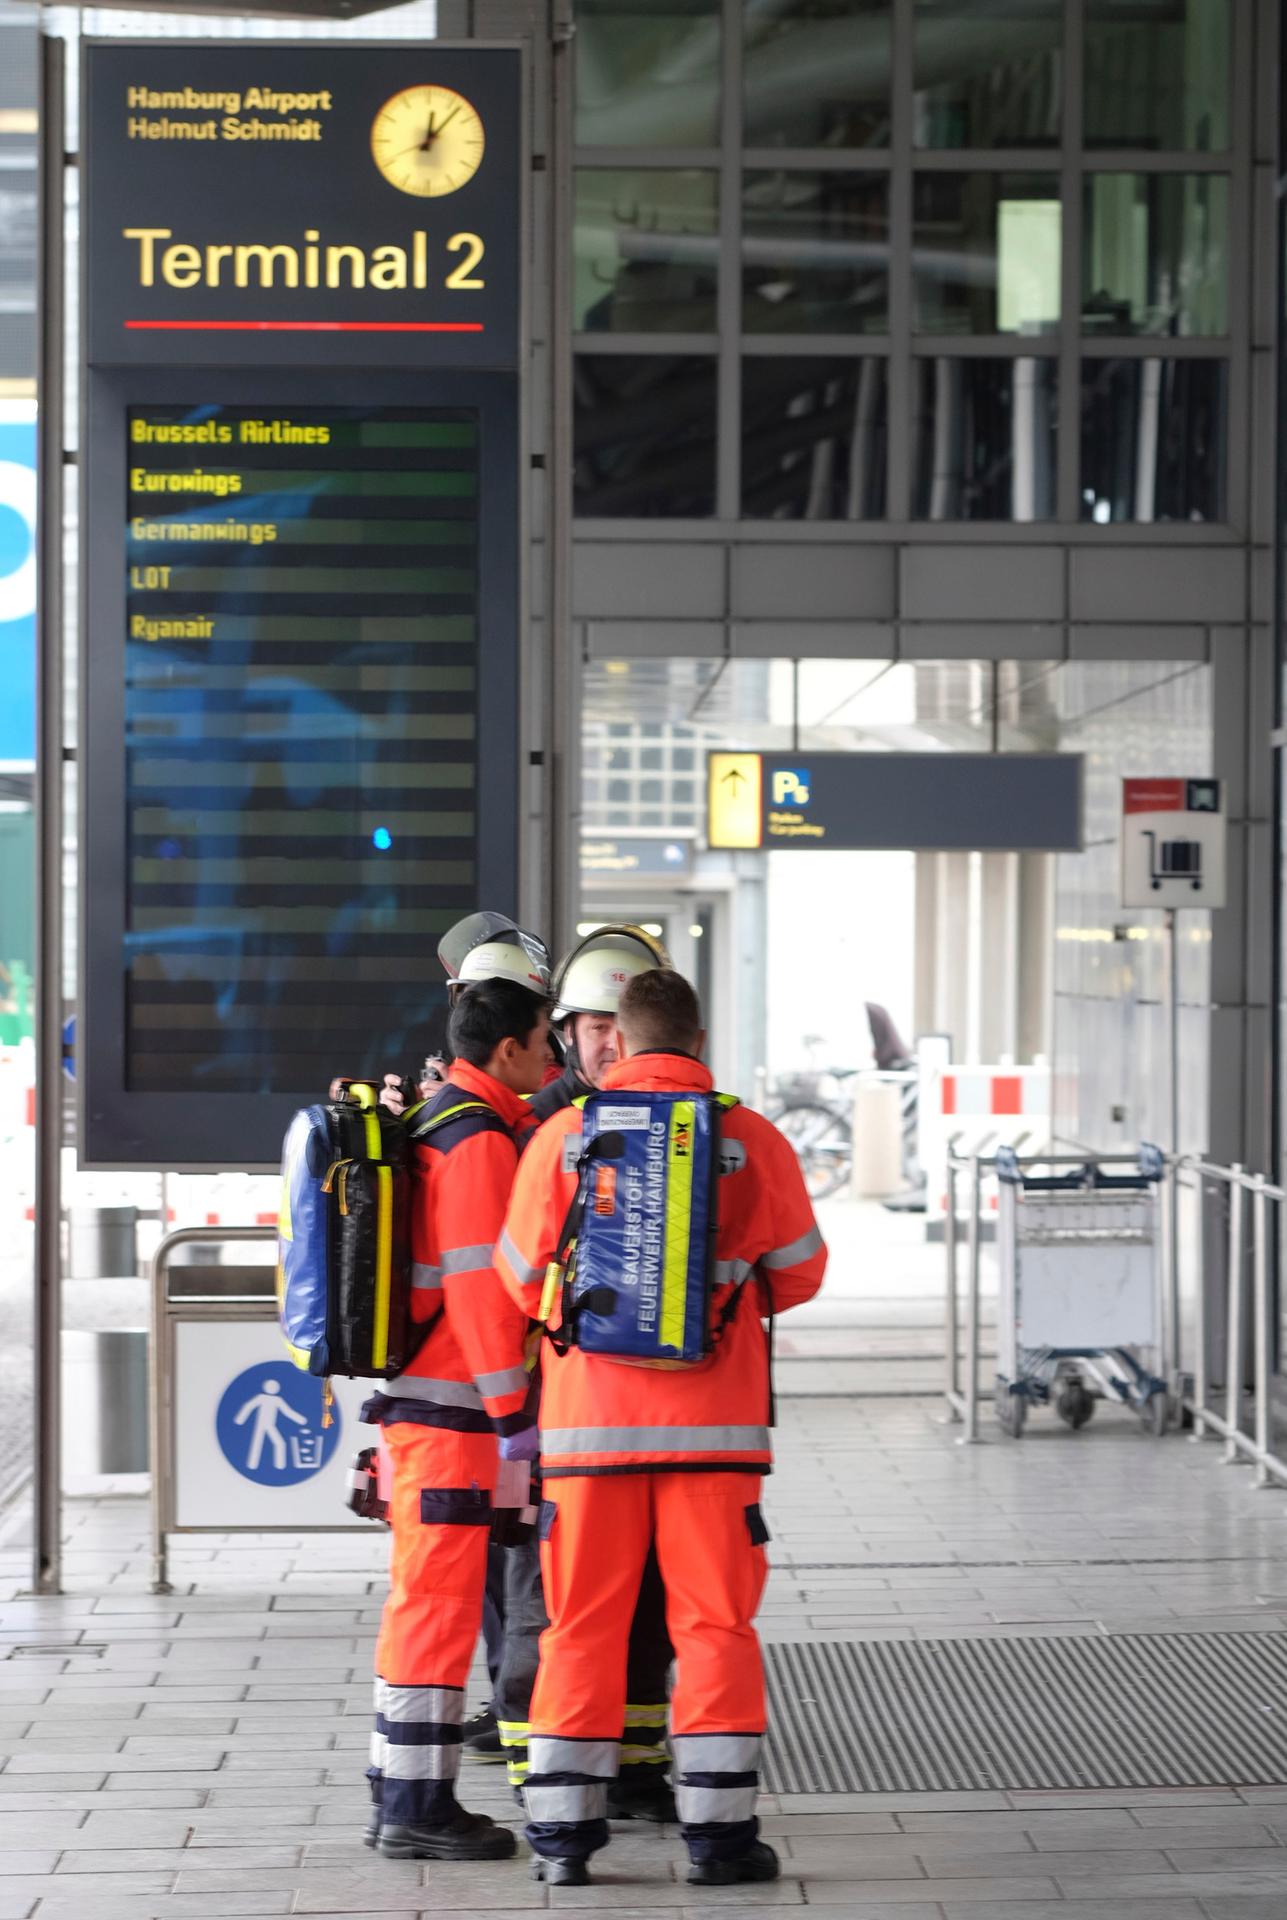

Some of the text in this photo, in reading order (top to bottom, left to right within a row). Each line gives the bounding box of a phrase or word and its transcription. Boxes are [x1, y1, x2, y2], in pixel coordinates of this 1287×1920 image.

[127, 86, 333, 114] Hamburg Airport
[127, 117, 322, 141] Helmut Schmidt
[122, 228, 486, 290] Terminal 2
[131, 419, 331, 444] Brussels Airlines
[130, 468, 242, 497] Eurowings
[131, 517, 278, 545] Germanwings
[131, 566, 172, 590] LOT
[131, 615, 216, 641] Ryanair
[624, 1165, 644, 1285] SAUERSTOFF
[638, 1122, 666, 1332] FEUERWEHR HAMBURG
